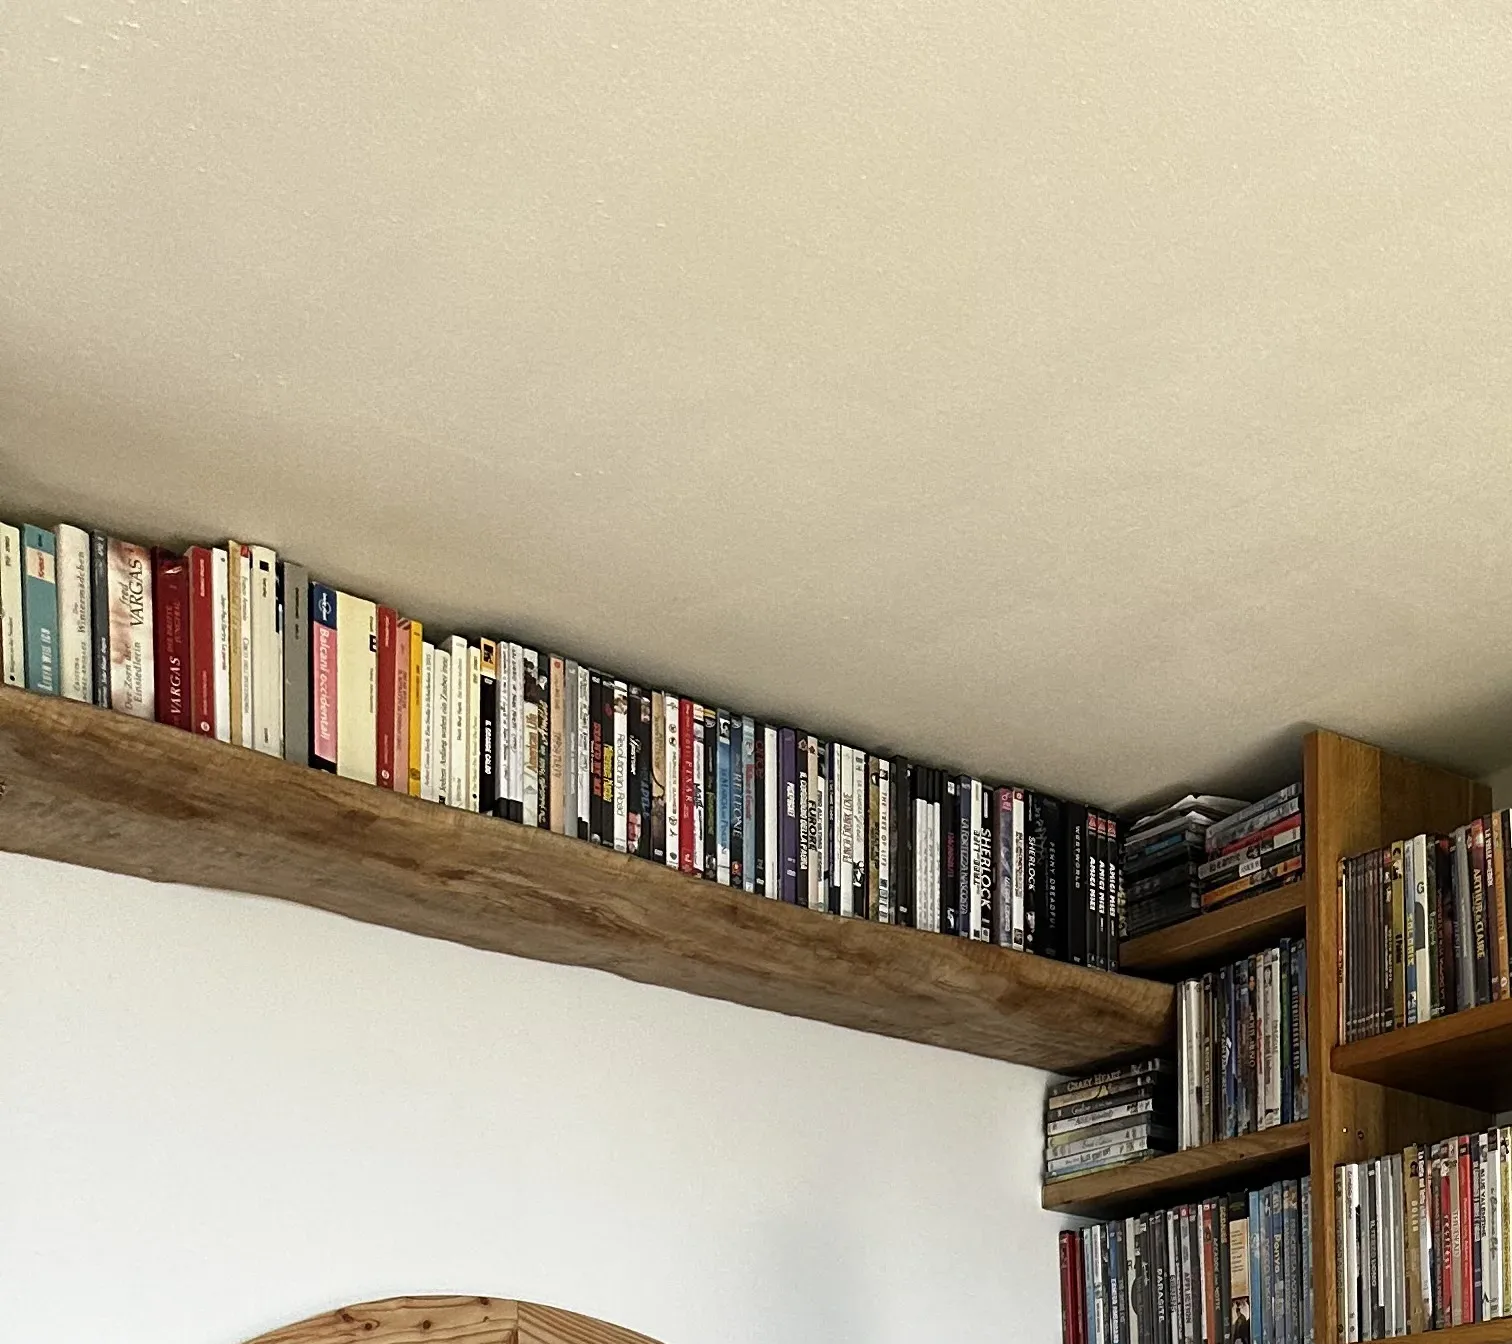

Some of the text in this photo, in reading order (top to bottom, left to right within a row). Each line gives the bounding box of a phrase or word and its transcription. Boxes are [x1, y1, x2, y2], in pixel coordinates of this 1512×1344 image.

[130, 559, 143, 627] VARGAS
[133, 642, 141, 703] Einsiedlerin
[170, 656, 181, 714] VARGAS
[319, 628, 331, 741] Balcani occidentali
[616, 733, 625, 817] Revolutionary Road
[808, 800, 817, 851] FURORE
[981, 828, 991, 909] SHERLOCK
